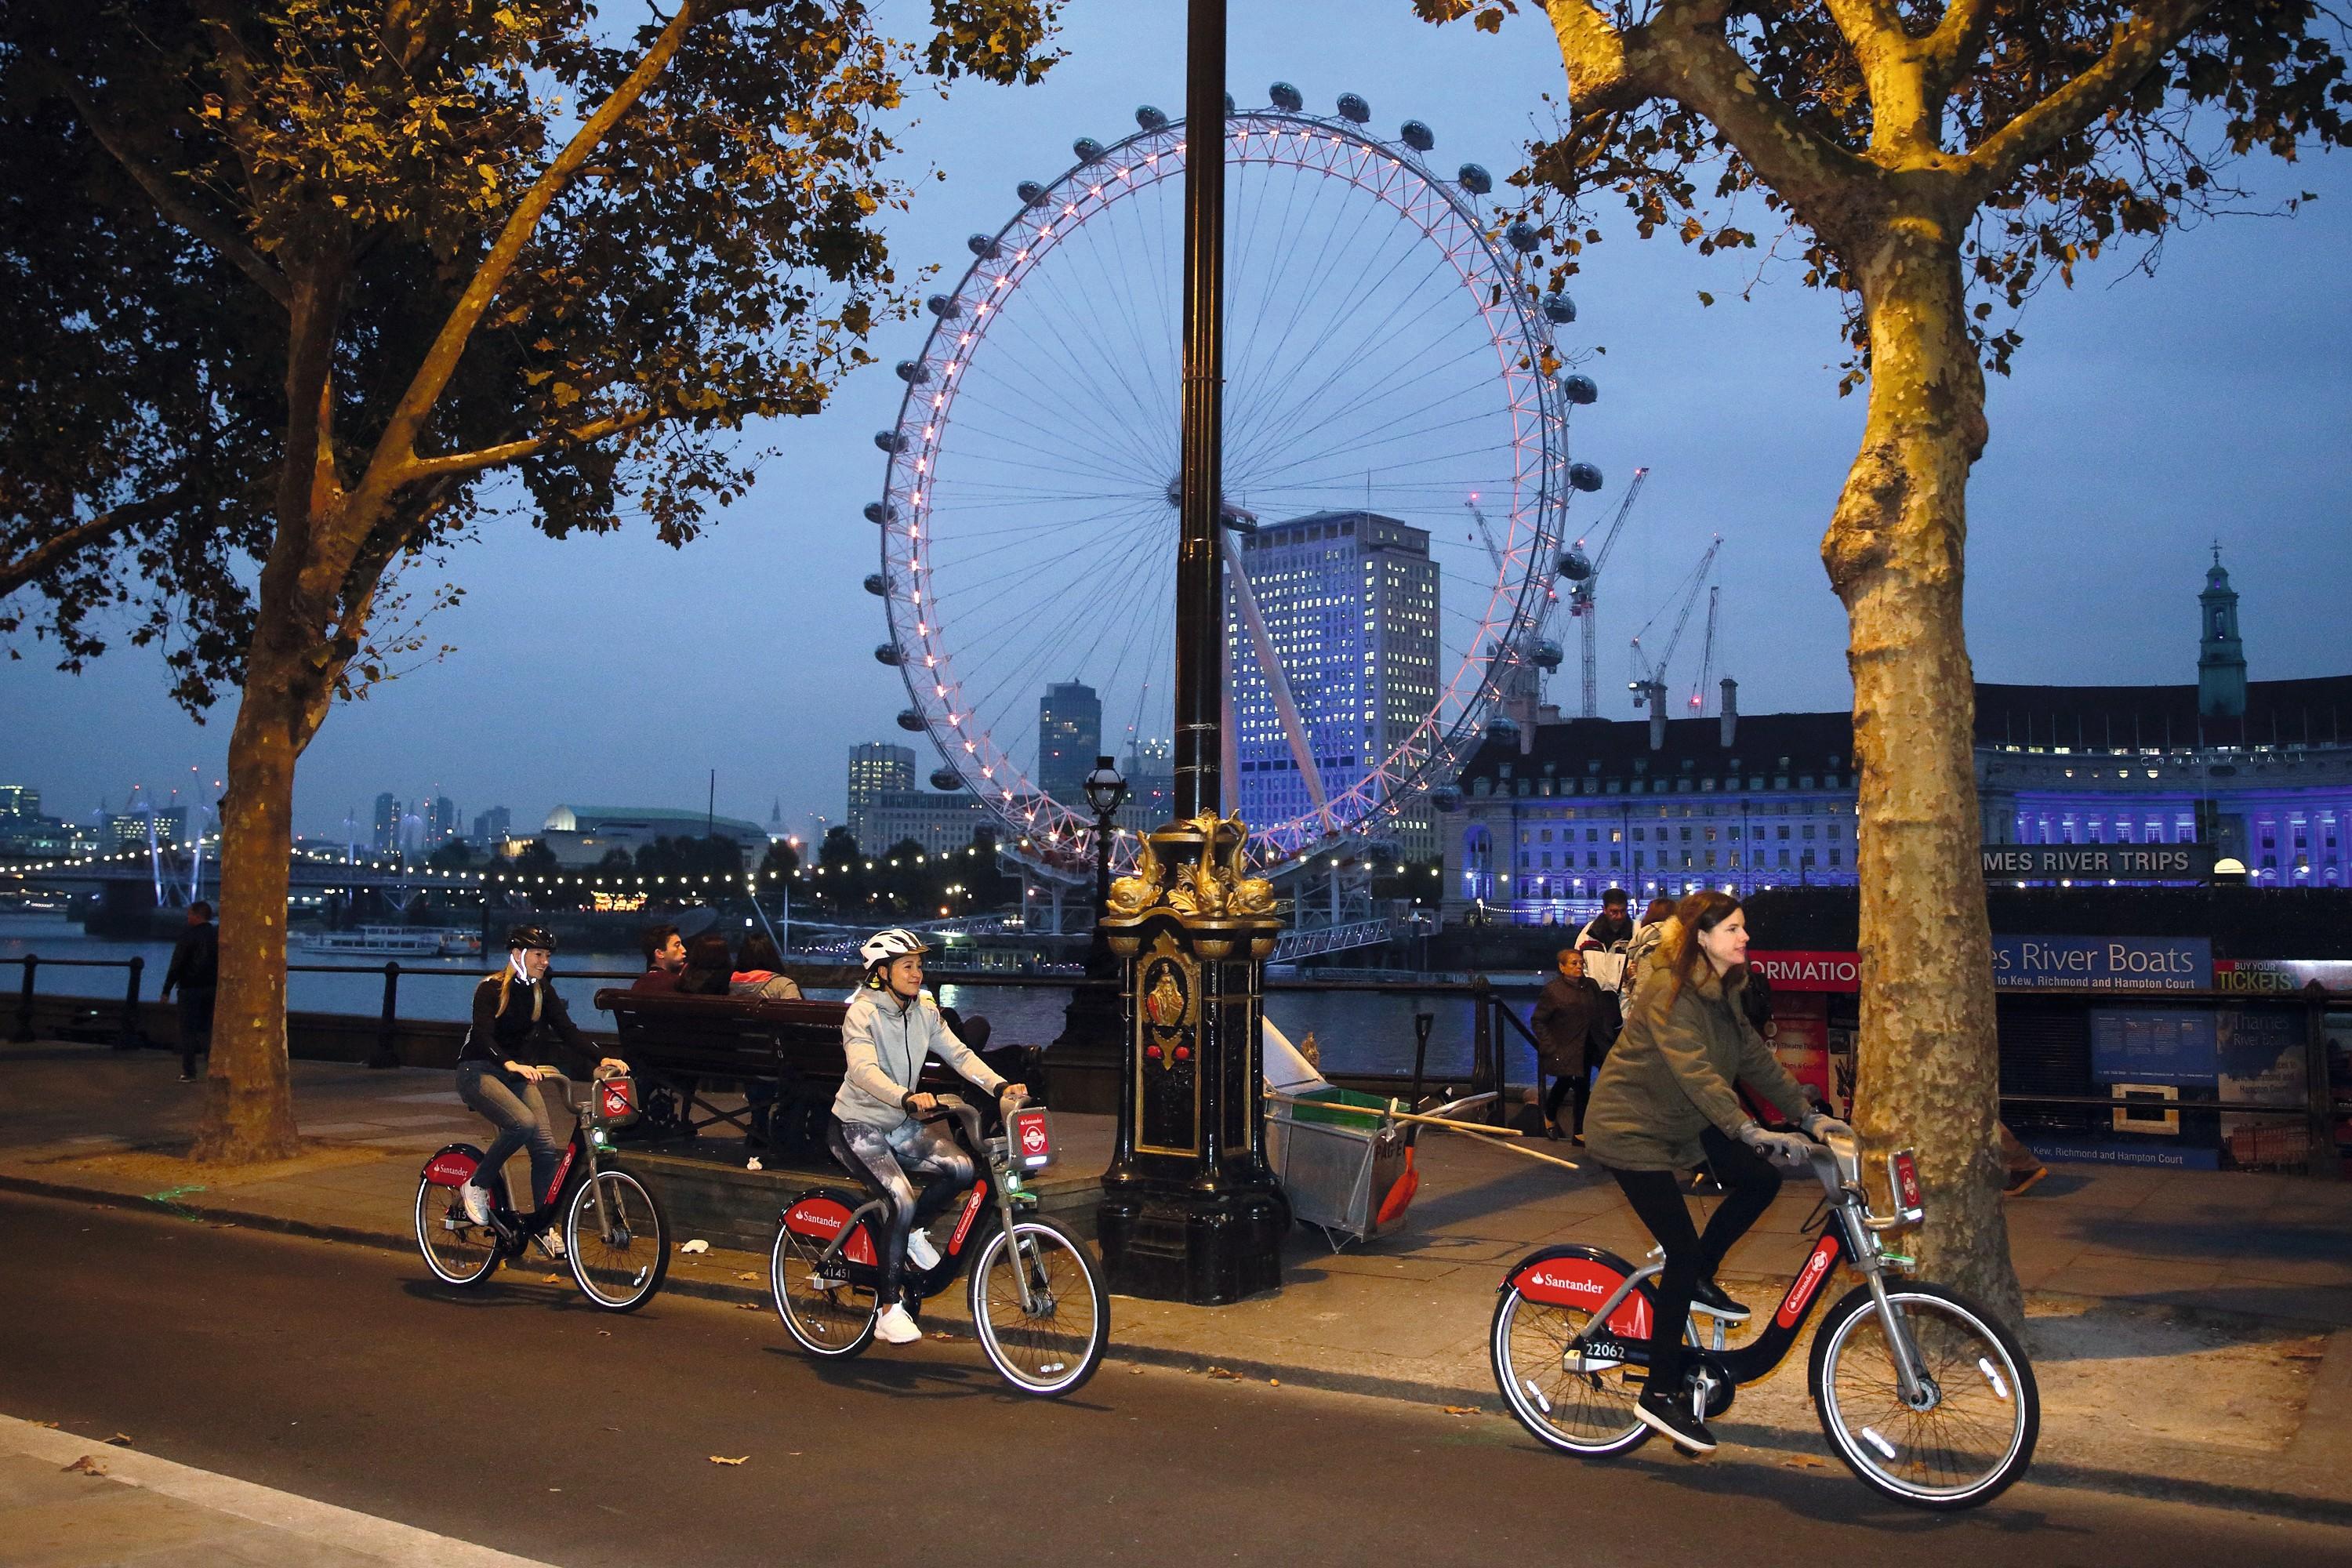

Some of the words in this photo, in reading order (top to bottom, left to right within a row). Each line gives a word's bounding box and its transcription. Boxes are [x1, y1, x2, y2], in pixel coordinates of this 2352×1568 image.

[2043, 851, 2109, 871] RIVER
[2119, 851, 2190, 871] TRIPS
[2022, 942, 2098, 971] River
[2108, 943, 2194, 973] Boats
[2234, 962, 2251, 971] BUY
[2252, 962, 2276, 971] YOUR
[1750, 960, 1863, 982] ORMATIO
[1998, 975, 2007, 985] to
[2011, 975, 2034, 987] Kew,
[2038, 976, 2089, 987] Richmond
[2092, 977, 2111, 988] and
[2115, 977, 2162, 989] Hampton
[2165, 978, 2196, 989] Court
[2218, 971, 2292, 991] TICKETS
[2033, 1146, 2053, 1156] Kew,
[2055, 1147, 2097, 1159] Richmond
[2100, 1151, 2115, 1160] and
[2118, 1152, 2156, 1163] Hampton
[2158, 1153, 2183, 1164] Court
[440, 1163, 468, 1177] Santander
[804, 1210, 841, 1229] Santander
[823, 1268, 851, 1279] 41451
[1544, 1273, 1604, 1294] Santander
[1792, 1271, 1814, 1303] Santander
[1586, 1343, 1625, 1359] 22062
